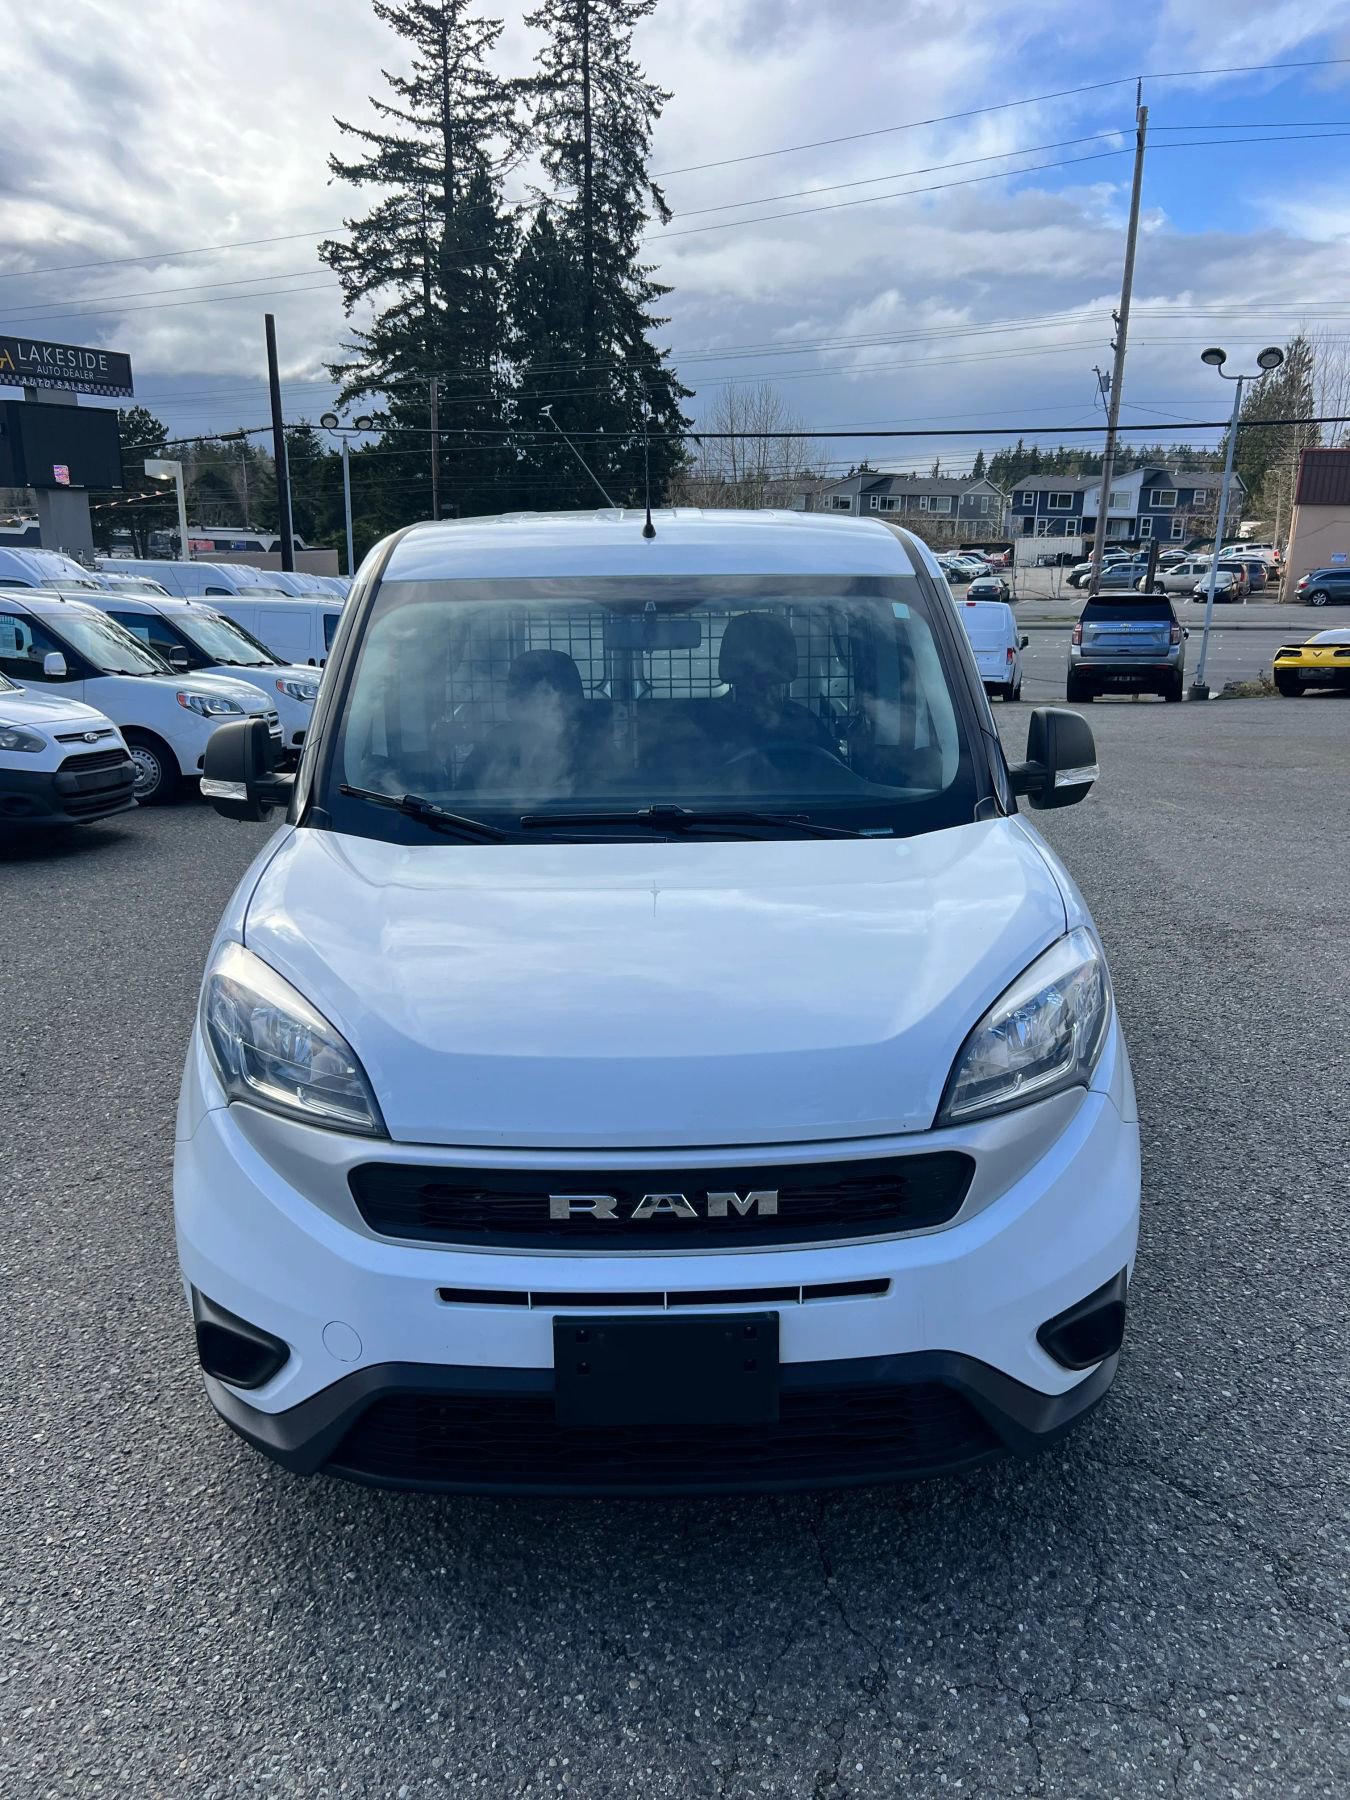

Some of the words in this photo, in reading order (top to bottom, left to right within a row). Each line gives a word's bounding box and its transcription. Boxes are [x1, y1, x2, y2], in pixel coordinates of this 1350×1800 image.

[17, 343, 108, 371] LAKESIDE
[36, 365, 61, 376] AUTO
[63, 368, 95, 380] DEALER
[21, 377, 51, 388] AUTO
[57, 381, 90, 392] SALES
[549, 1190, 778, 1219] RAM
